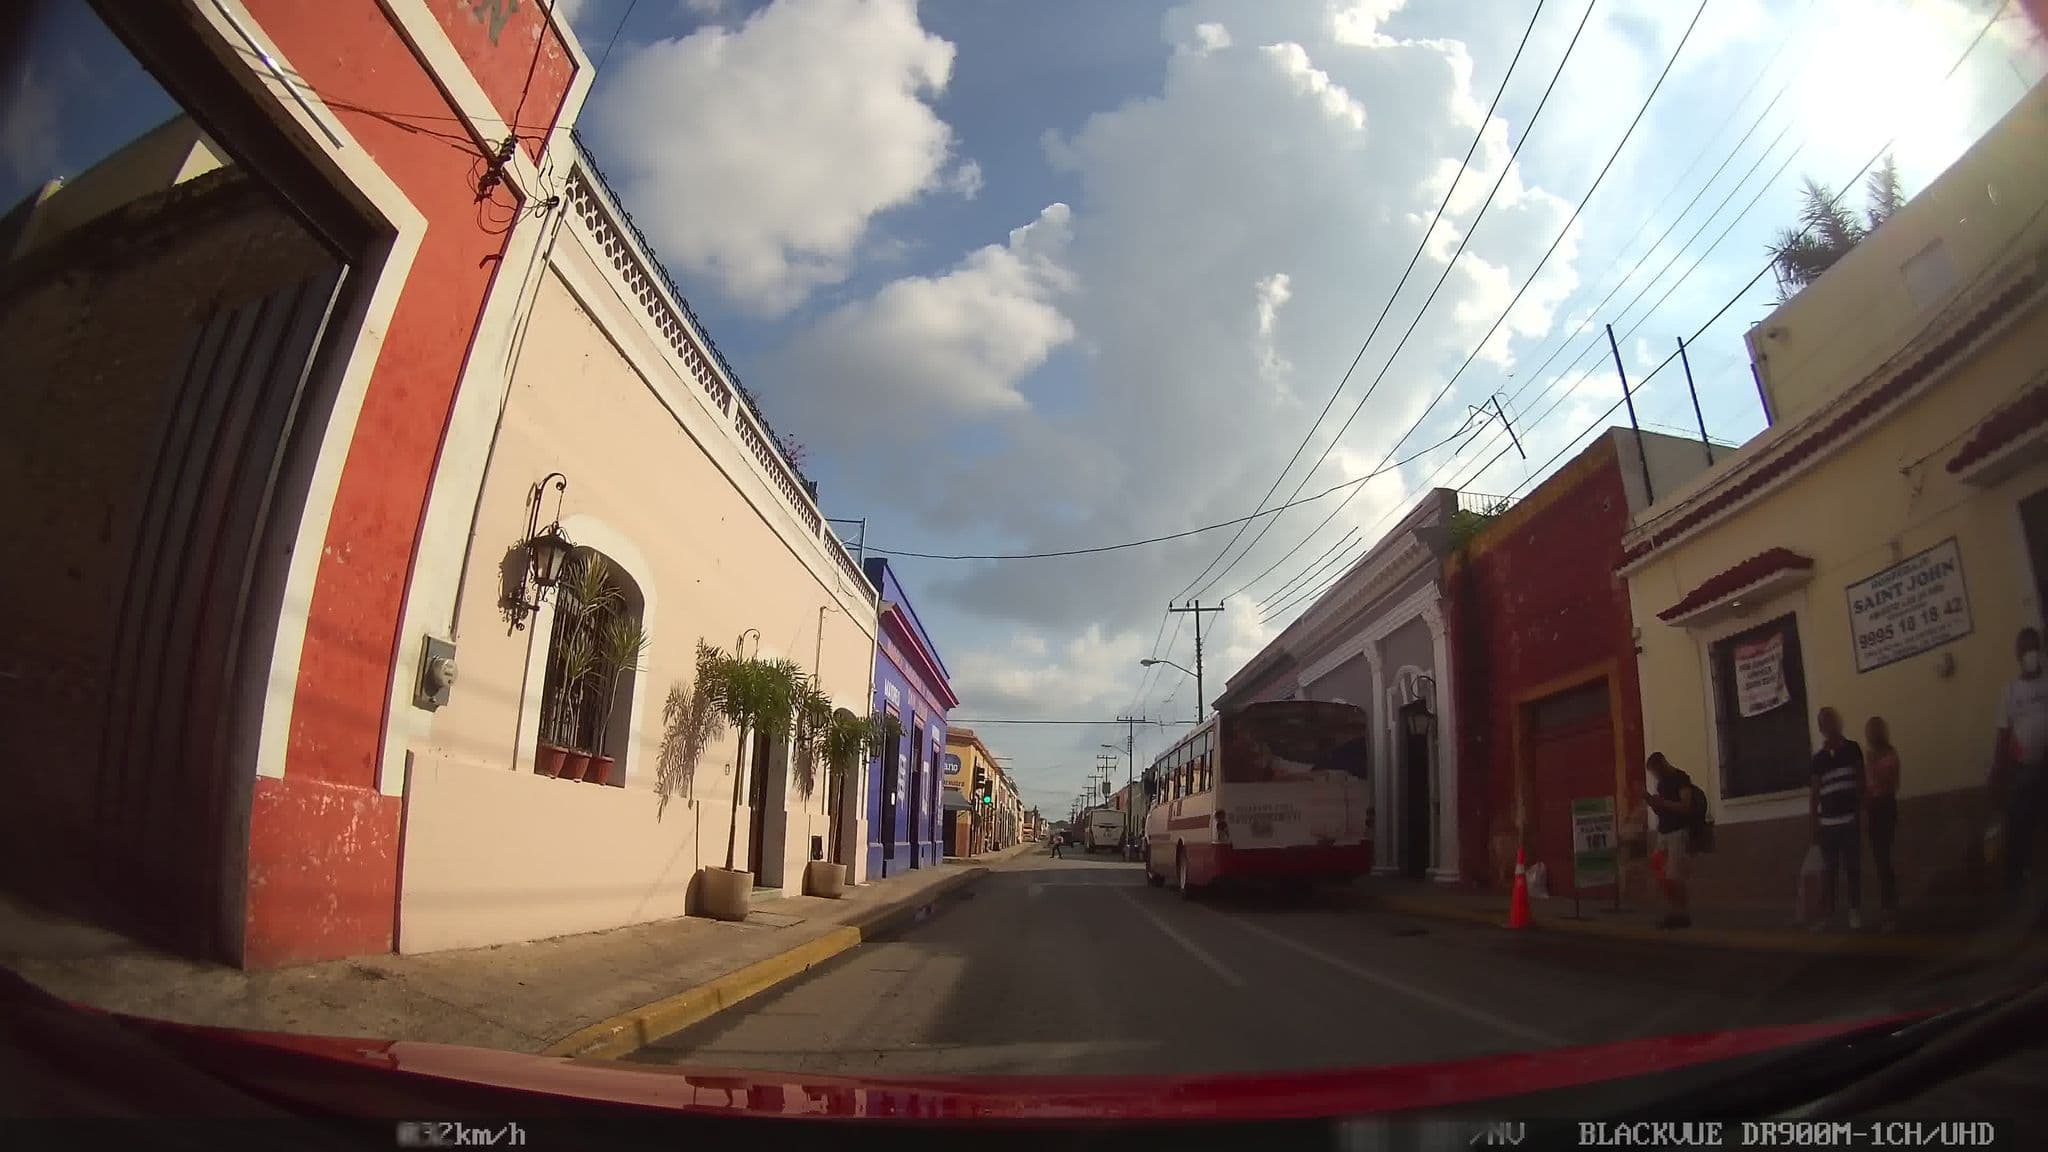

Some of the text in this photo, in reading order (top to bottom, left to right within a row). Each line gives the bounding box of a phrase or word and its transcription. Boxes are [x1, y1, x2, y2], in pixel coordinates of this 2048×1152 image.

[1853, 582, 1903, 614] SAINT
[1906, 557, 1955, 592] JOHN
[1859, 624, 1895, 649] 9995
[1899, 615, 1916, 633] 18
[1921, 606, 1938, 624] 18
